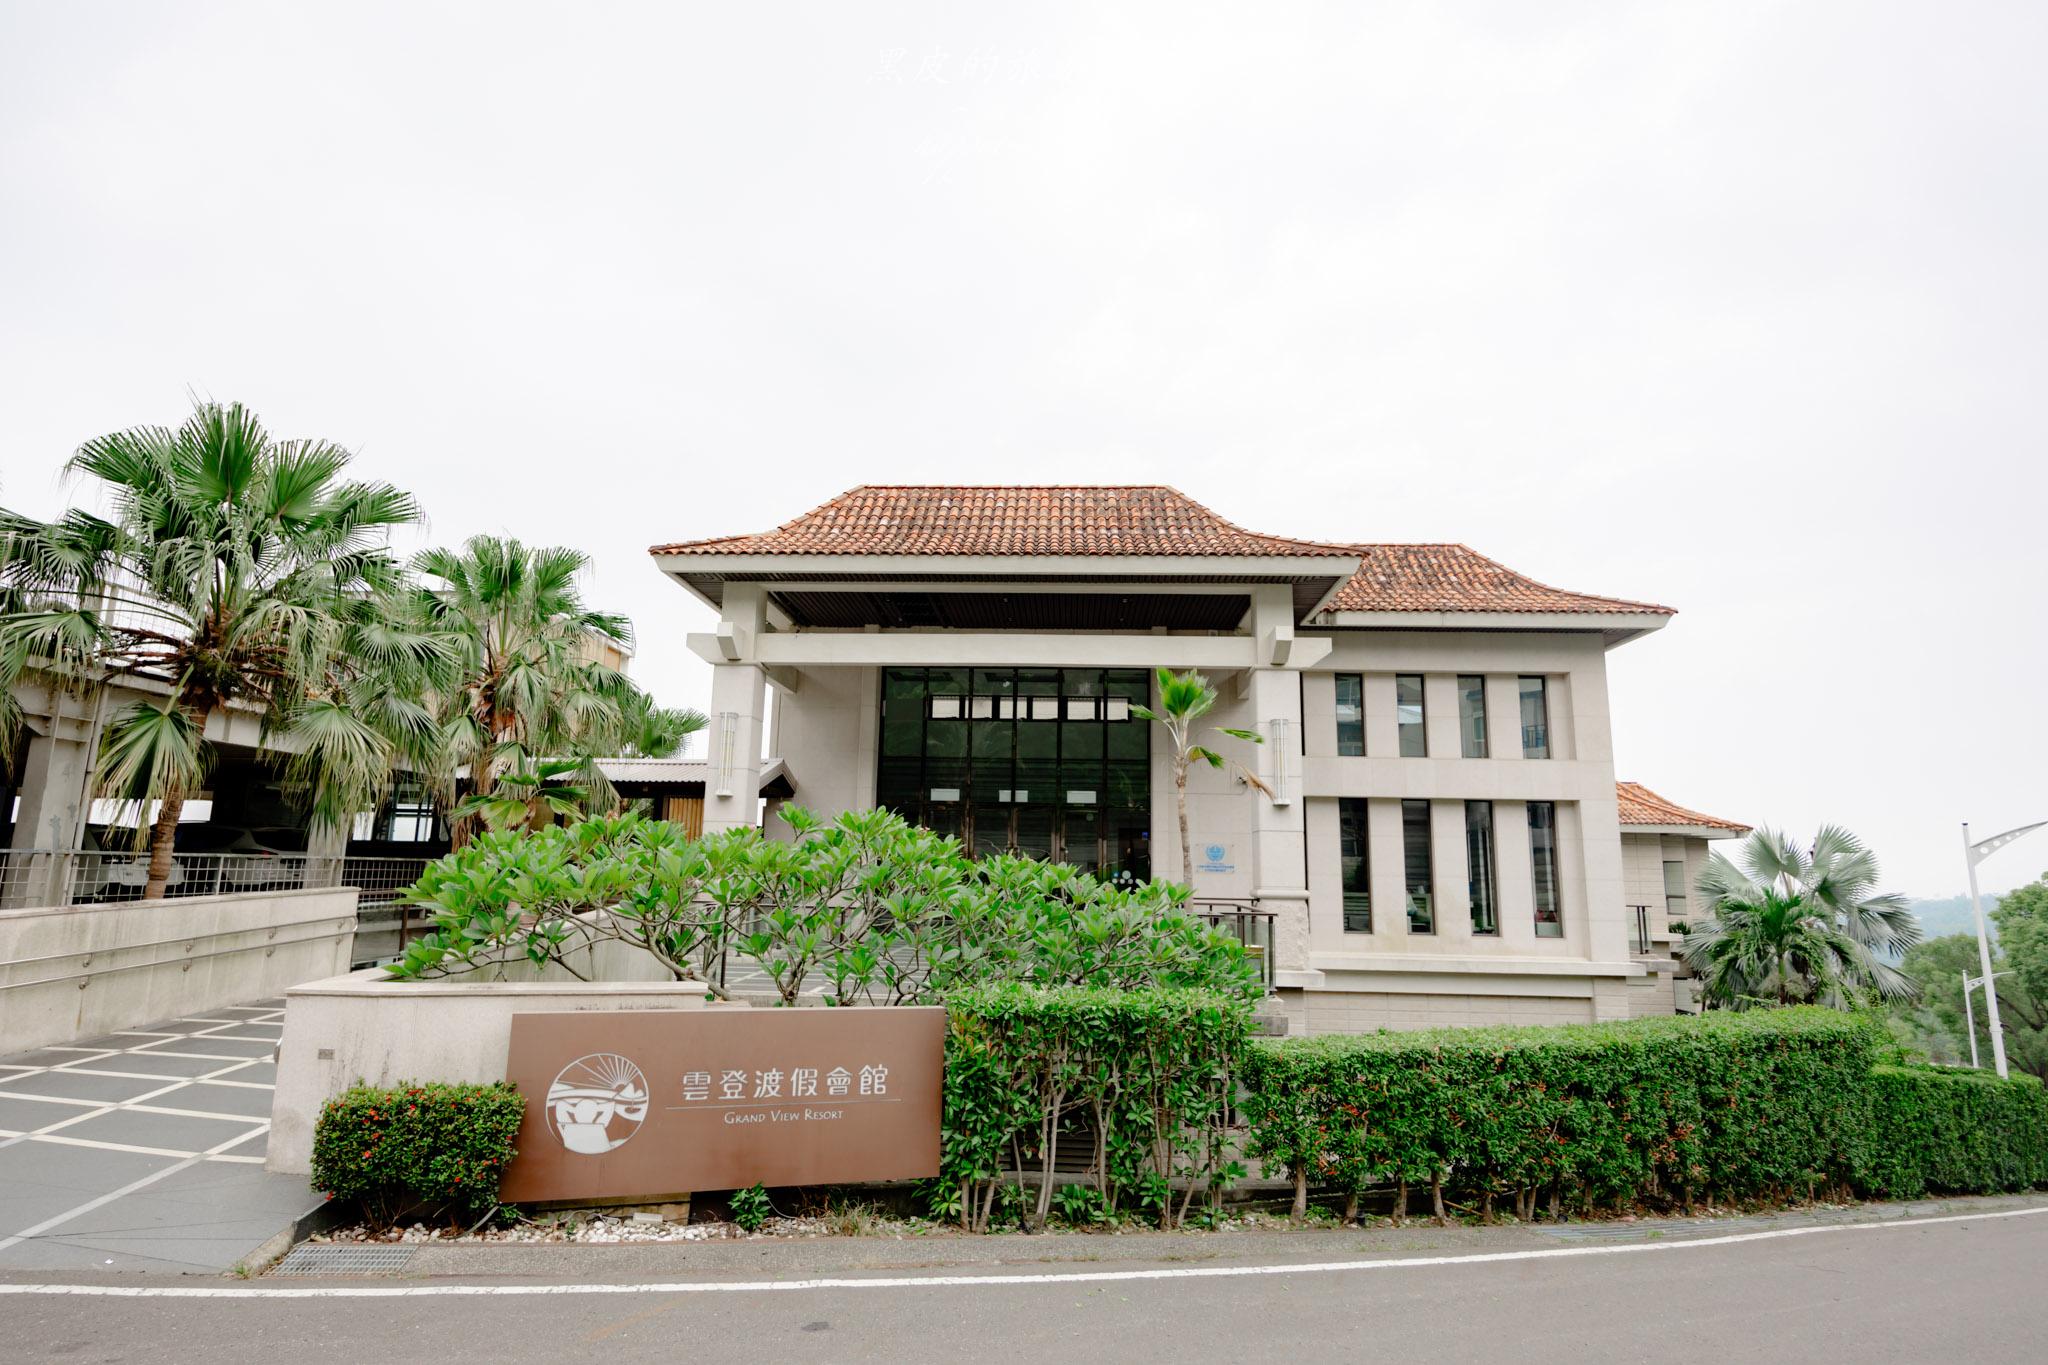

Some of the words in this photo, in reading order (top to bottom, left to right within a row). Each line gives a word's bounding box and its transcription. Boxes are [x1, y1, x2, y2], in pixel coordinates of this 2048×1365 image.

[682, 1064, 889, 1101] 雲登渡假會館
